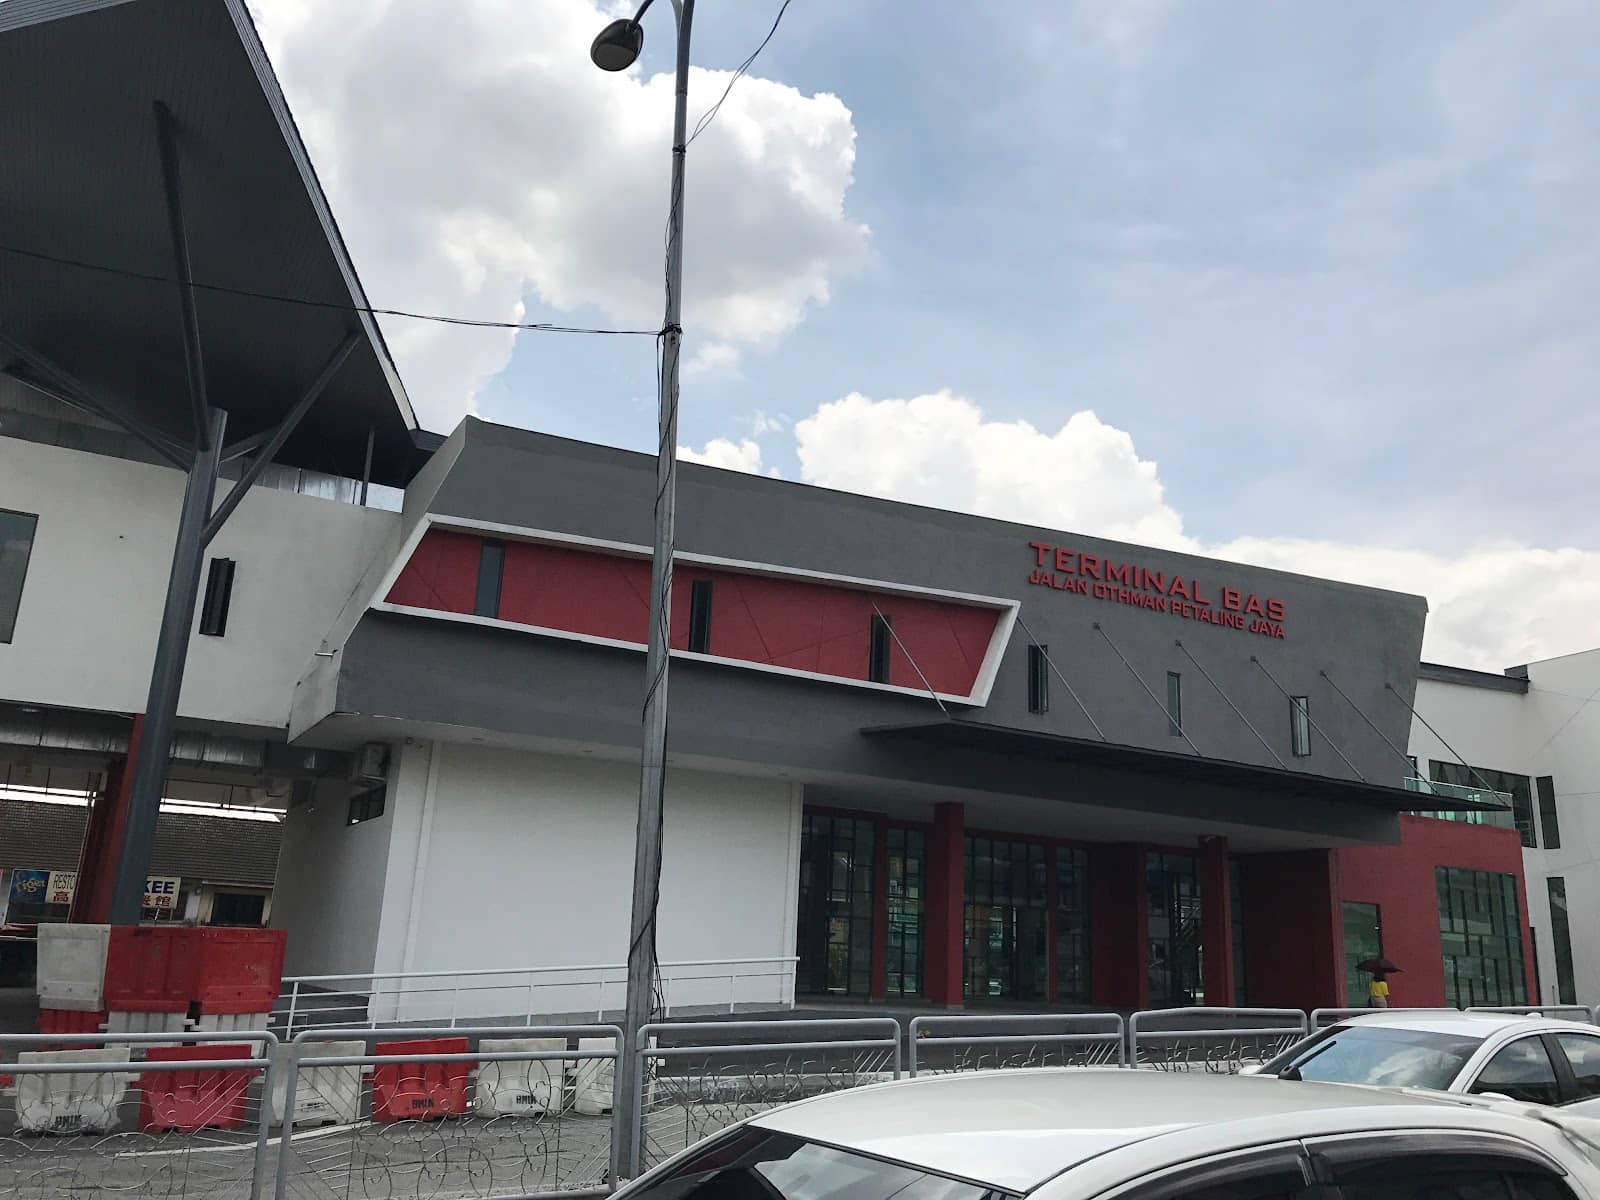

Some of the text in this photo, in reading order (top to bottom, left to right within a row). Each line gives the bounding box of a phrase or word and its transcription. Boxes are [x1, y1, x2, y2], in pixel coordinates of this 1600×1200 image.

[1028, 541, 1285, 622] TERMINAL BAS
[1028, 569, 1285, 639] JALAN OTHMAN PETALING JAYA
